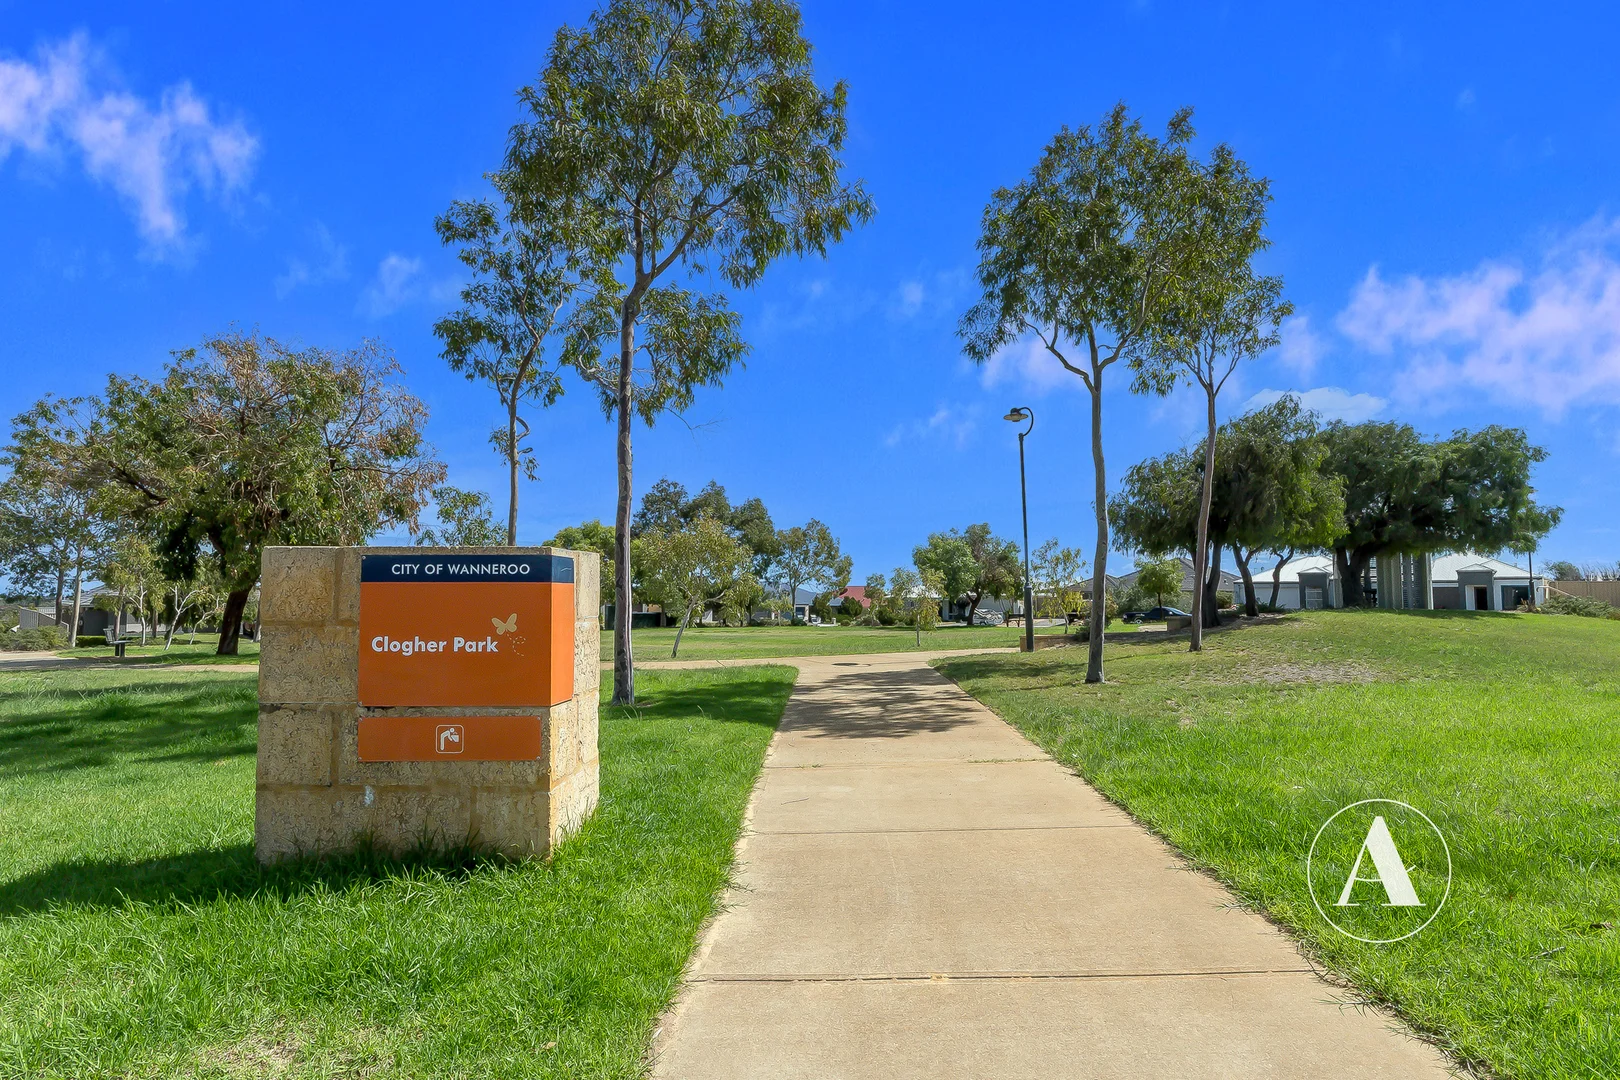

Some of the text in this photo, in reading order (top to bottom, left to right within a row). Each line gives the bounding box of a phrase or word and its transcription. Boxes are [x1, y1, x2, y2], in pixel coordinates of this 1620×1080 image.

[391, 563, 531, 575] CITY OF WANNEROO
[371, 636, 499, 656] Clogher Park
